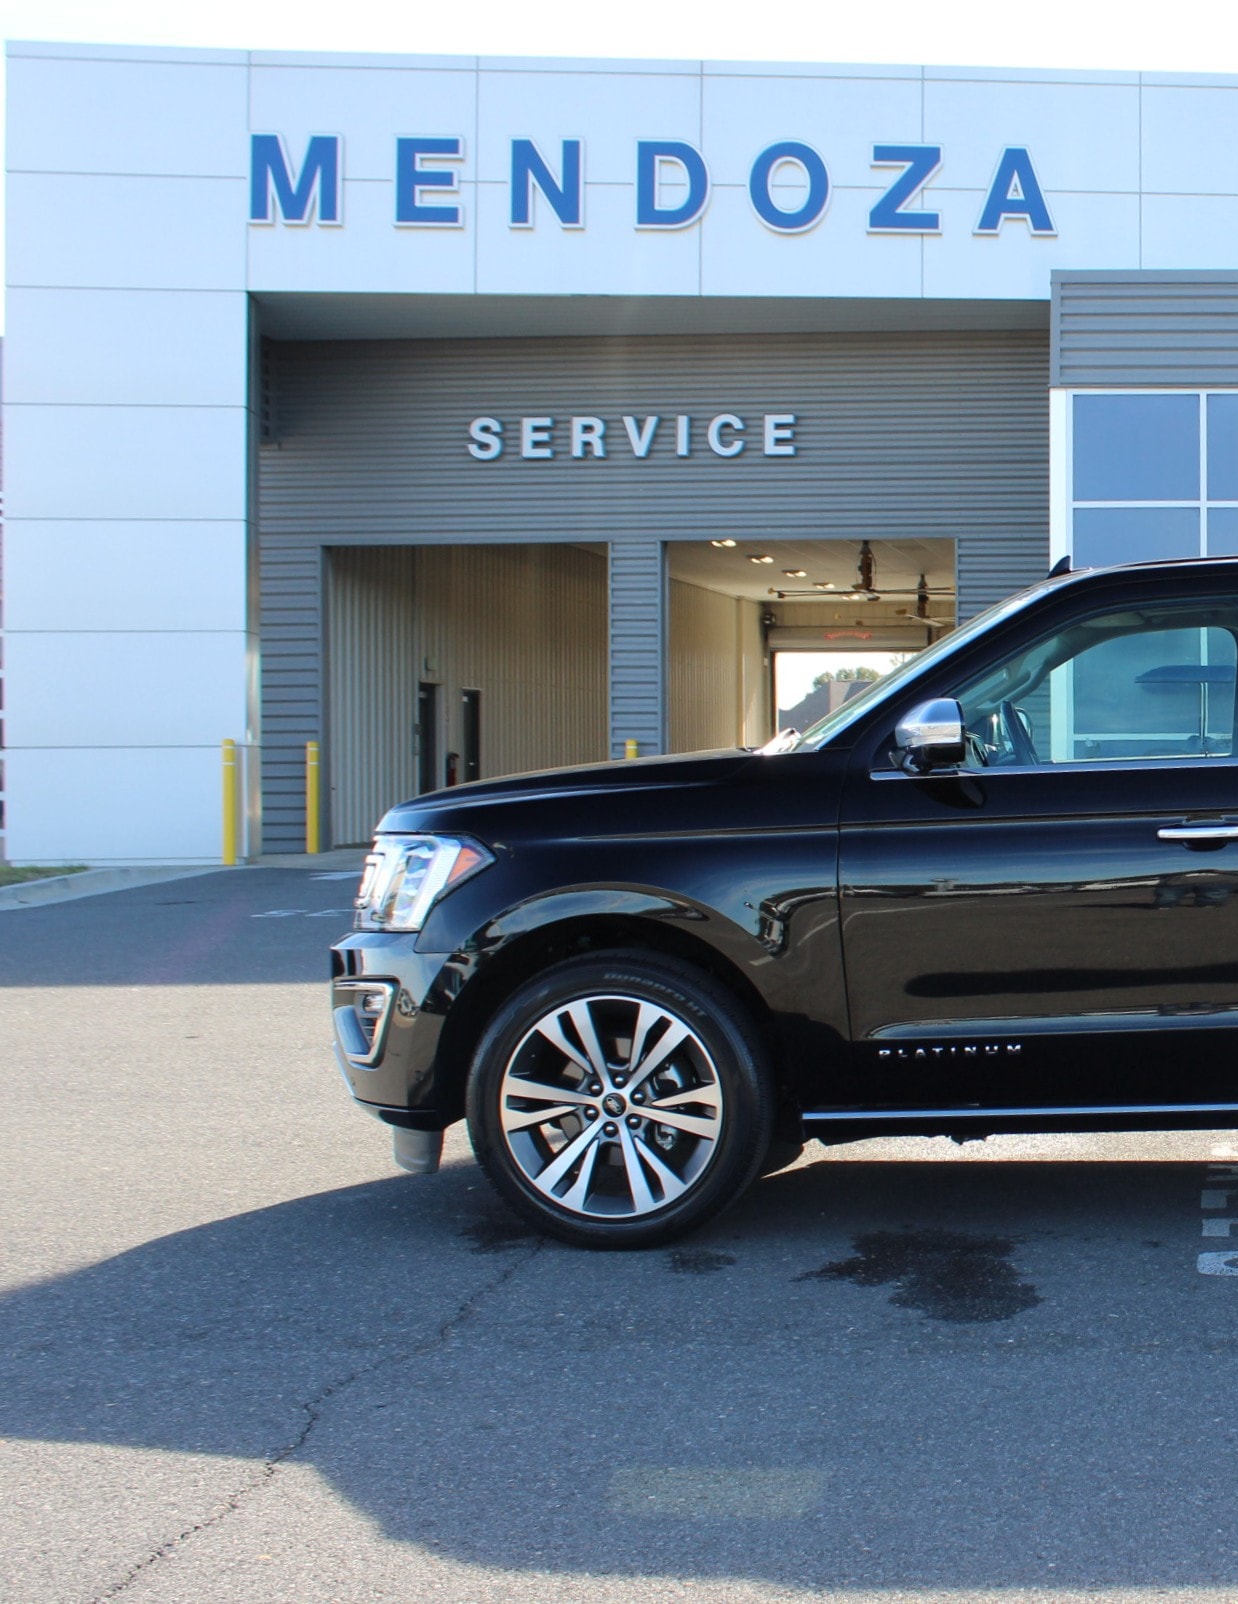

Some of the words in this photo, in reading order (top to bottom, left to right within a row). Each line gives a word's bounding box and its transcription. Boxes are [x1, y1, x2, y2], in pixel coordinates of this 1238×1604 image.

[248, 132, 1058, 238] MENDOZA
[466, 412, 798, 461] SERVICE
[877, 1044, 1023, 1059] PLATINUM
